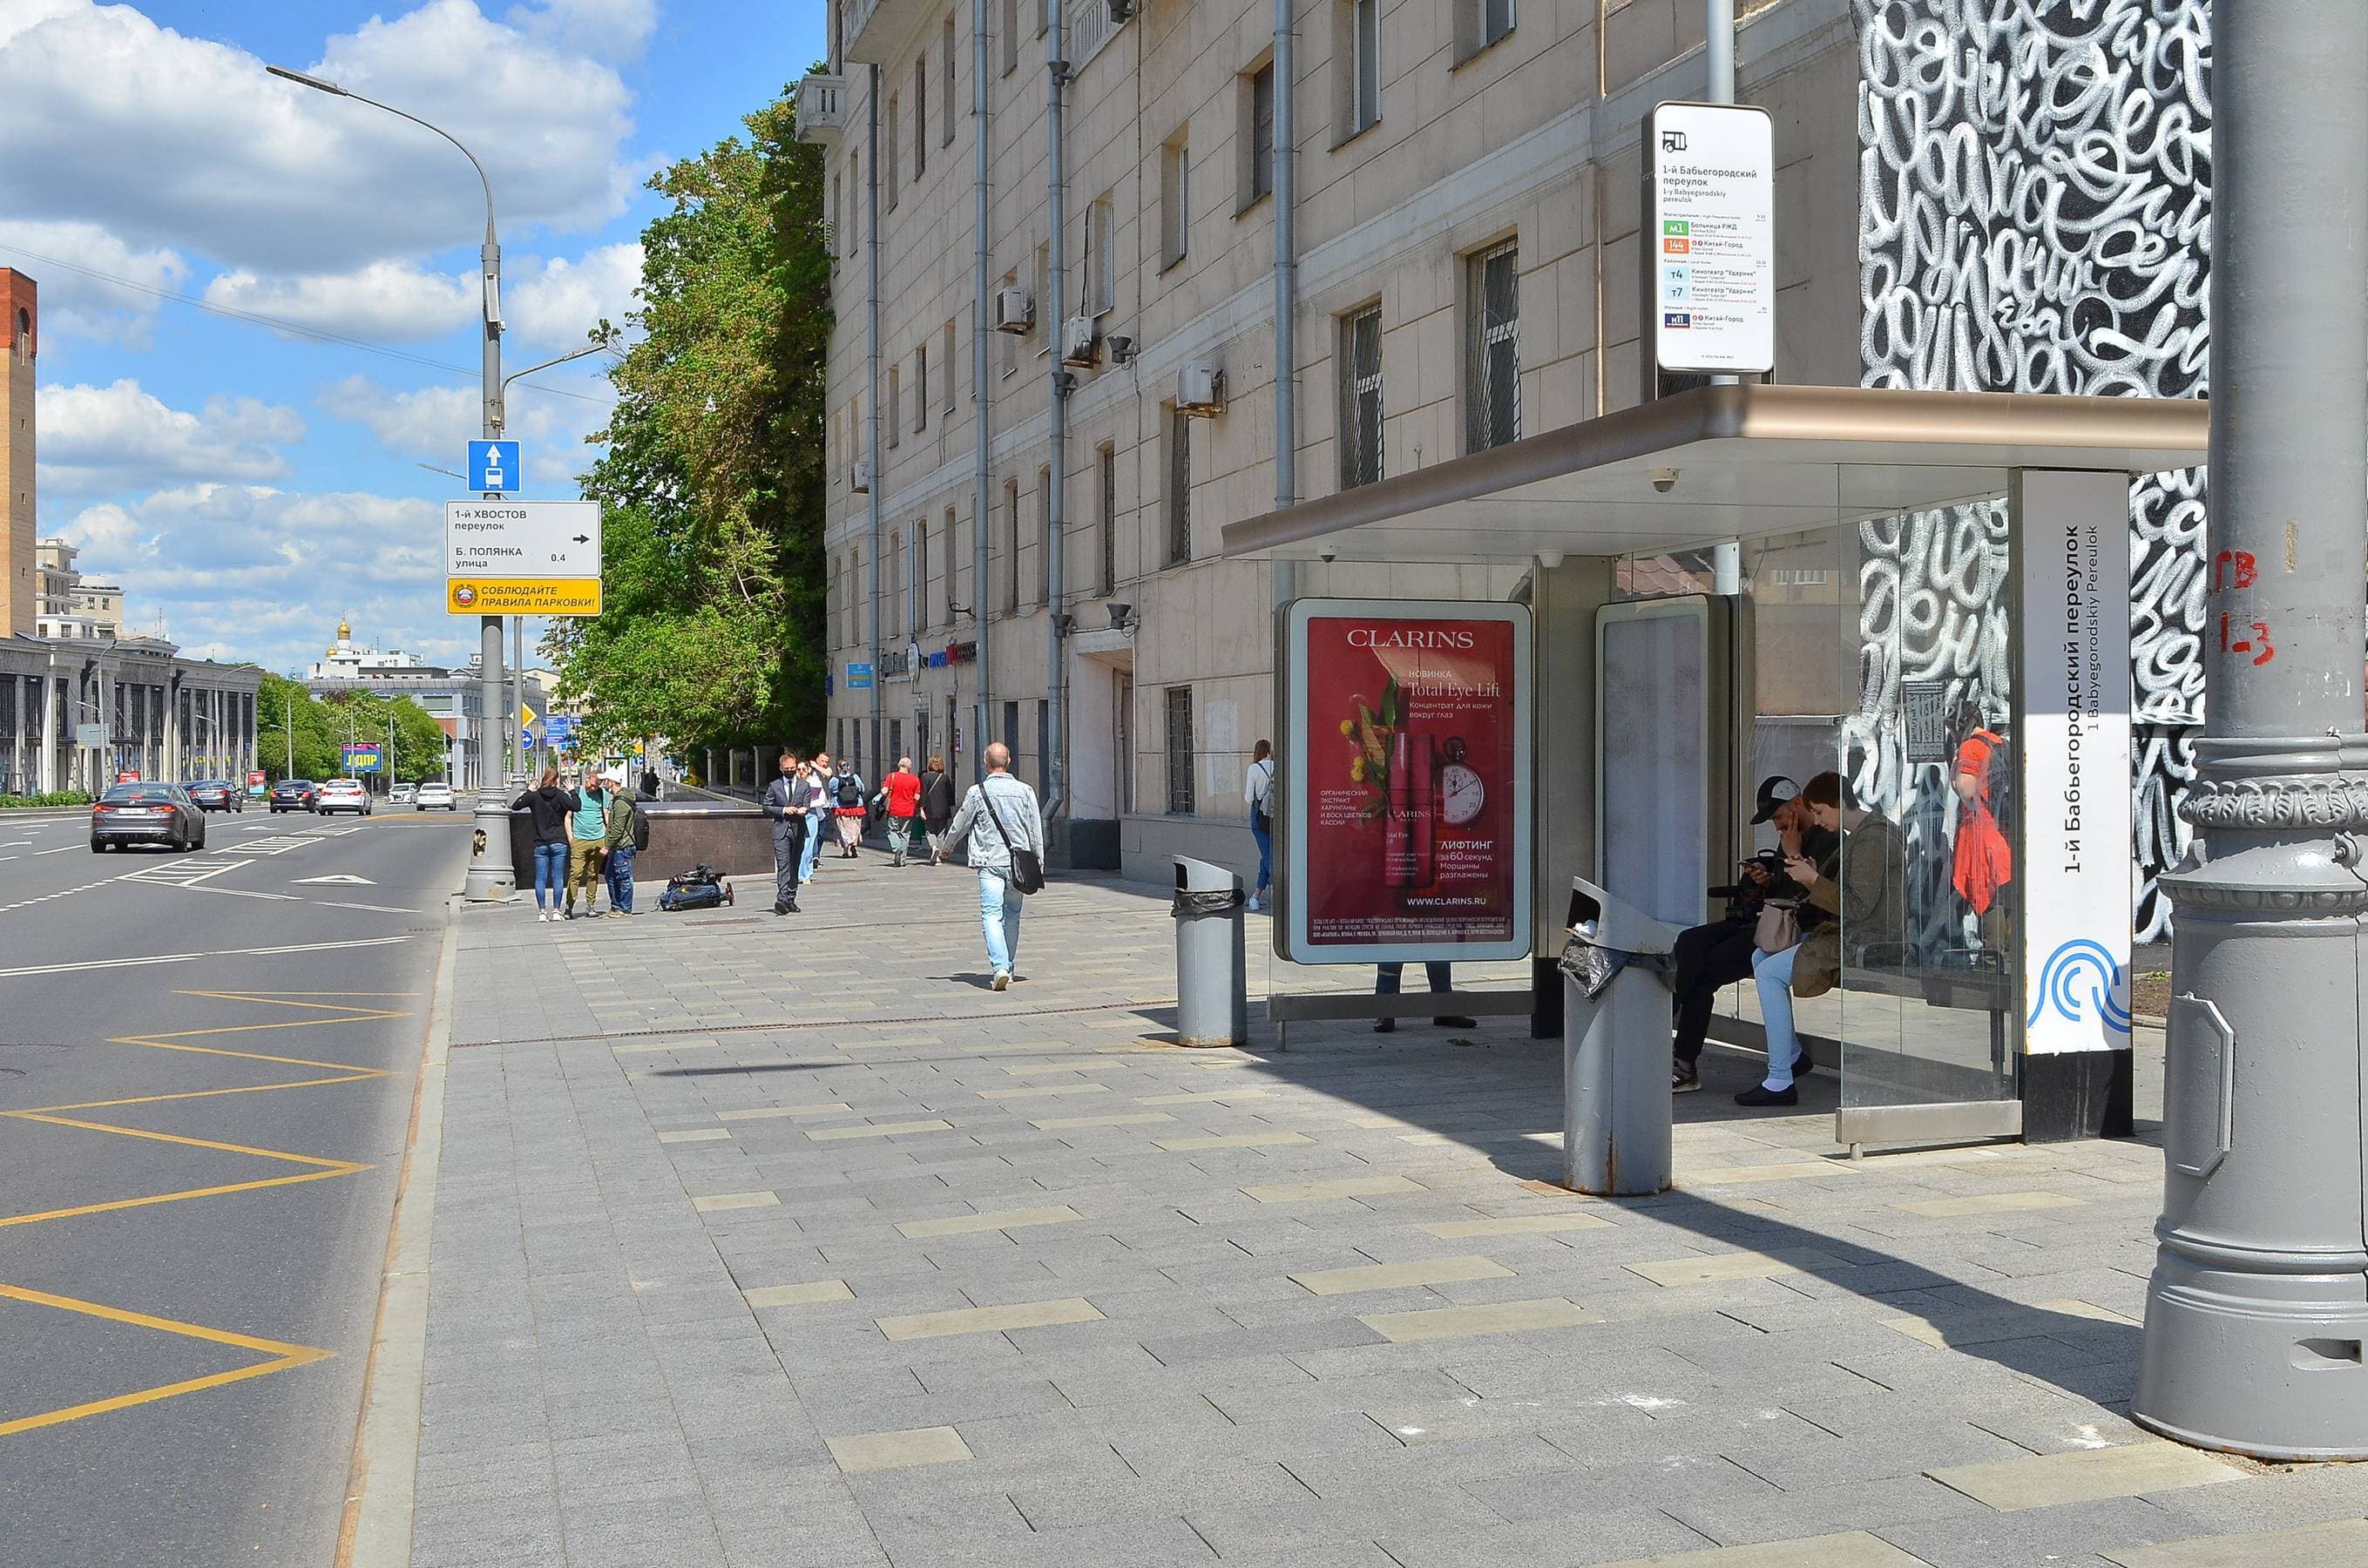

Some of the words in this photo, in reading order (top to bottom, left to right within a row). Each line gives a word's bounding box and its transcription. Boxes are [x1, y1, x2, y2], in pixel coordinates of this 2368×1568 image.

[1663, 166, 1677, 174] 1-й
[1680, 166, 1757, 179] Бабьегородский
[1663, 178, 1708, 187] переулок
[1668, 240, 1685, 250] 144
[455, 509, 470, 518] 1-й
[474, 510, 527, 519] ХВОСТОВ
[455, 523, 504, 531] переулок
[456, 547, 466, 556] Б.
[470, 547, 523, 556] ПОЛЯНКА
[551, 553, 565, 562] 0.4
[2086, 524, 2098, 591] Pereulok
[455, 560, 488, 569] улица
[2066, 524, 2082, 634] переулок
[481, 585, 558, 596] СОБЛЮДАЙТЕ
[1347, 629, 1474, 649] CLARINS
[2087, 597, 2101, 718] Babyegorodskiy
[1408, 681, 1443, 697] Total
[1448, 683, 1473, 701] Eye
[1477, 683, 1500, 697] Lift
[1409, 701, 1454, 711] Концентрат
[2063, 642, 2083, 831] Бабьегородский
[1440, 841, 1492, 850] ЛИФТИНГ
[1450, 852, 1464, 861] 60
[2065, 840, 2080, 873] 1-й
